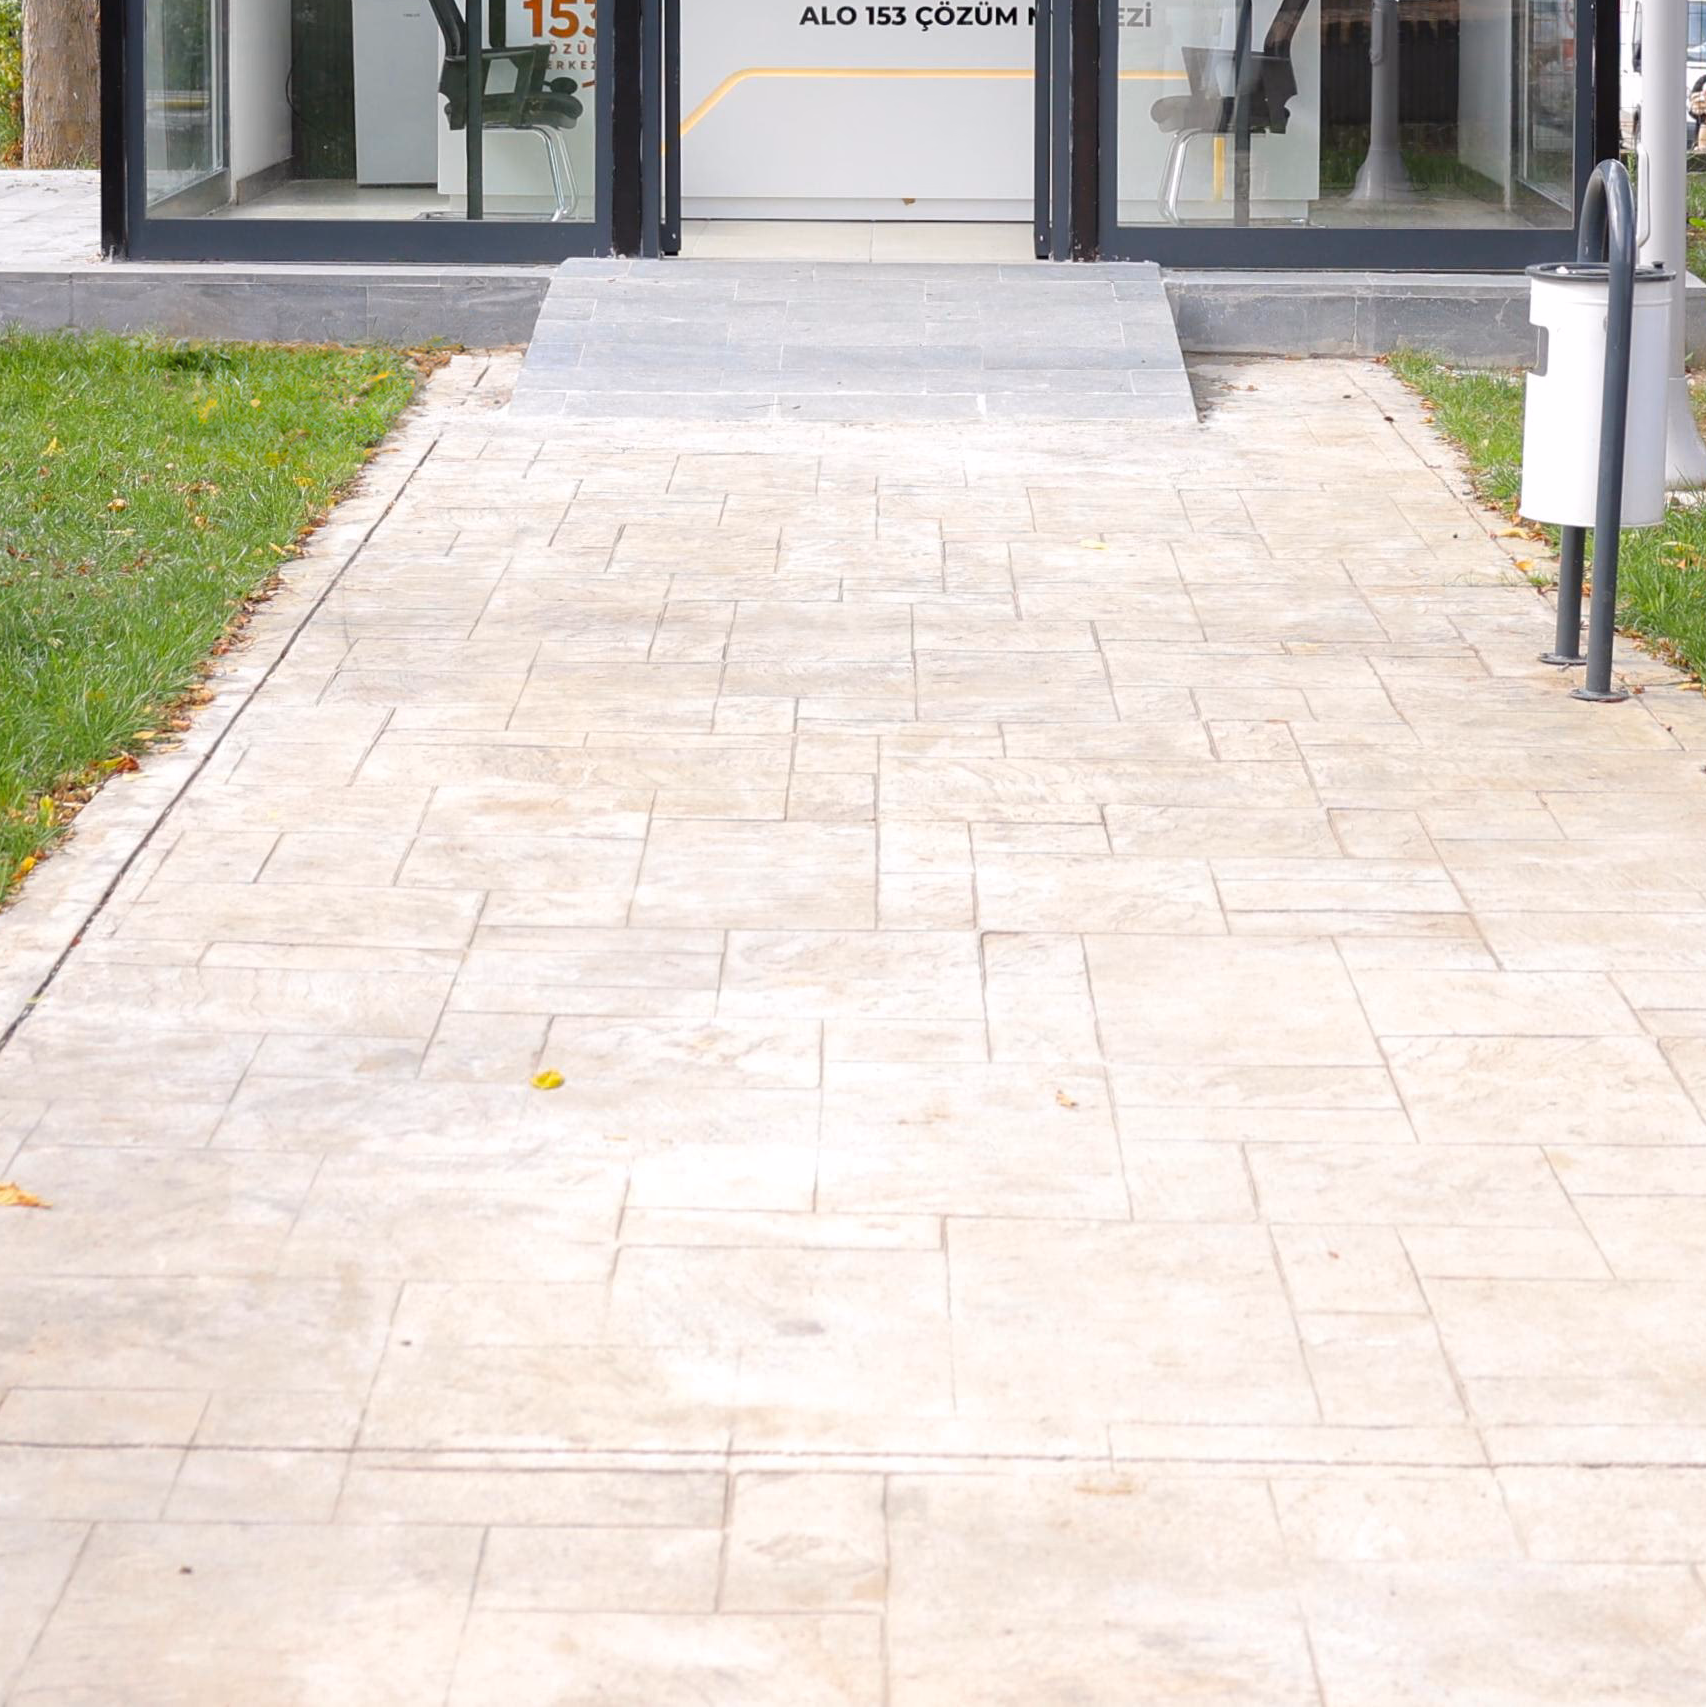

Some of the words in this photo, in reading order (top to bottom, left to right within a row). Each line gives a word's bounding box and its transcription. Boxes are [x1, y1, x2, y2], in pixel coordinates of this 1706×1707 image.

[799, 6, 857, 26] ALO
[865, 6, 907, 26] 153
[915, 0, 1018, 31] ÇÖZÜM
